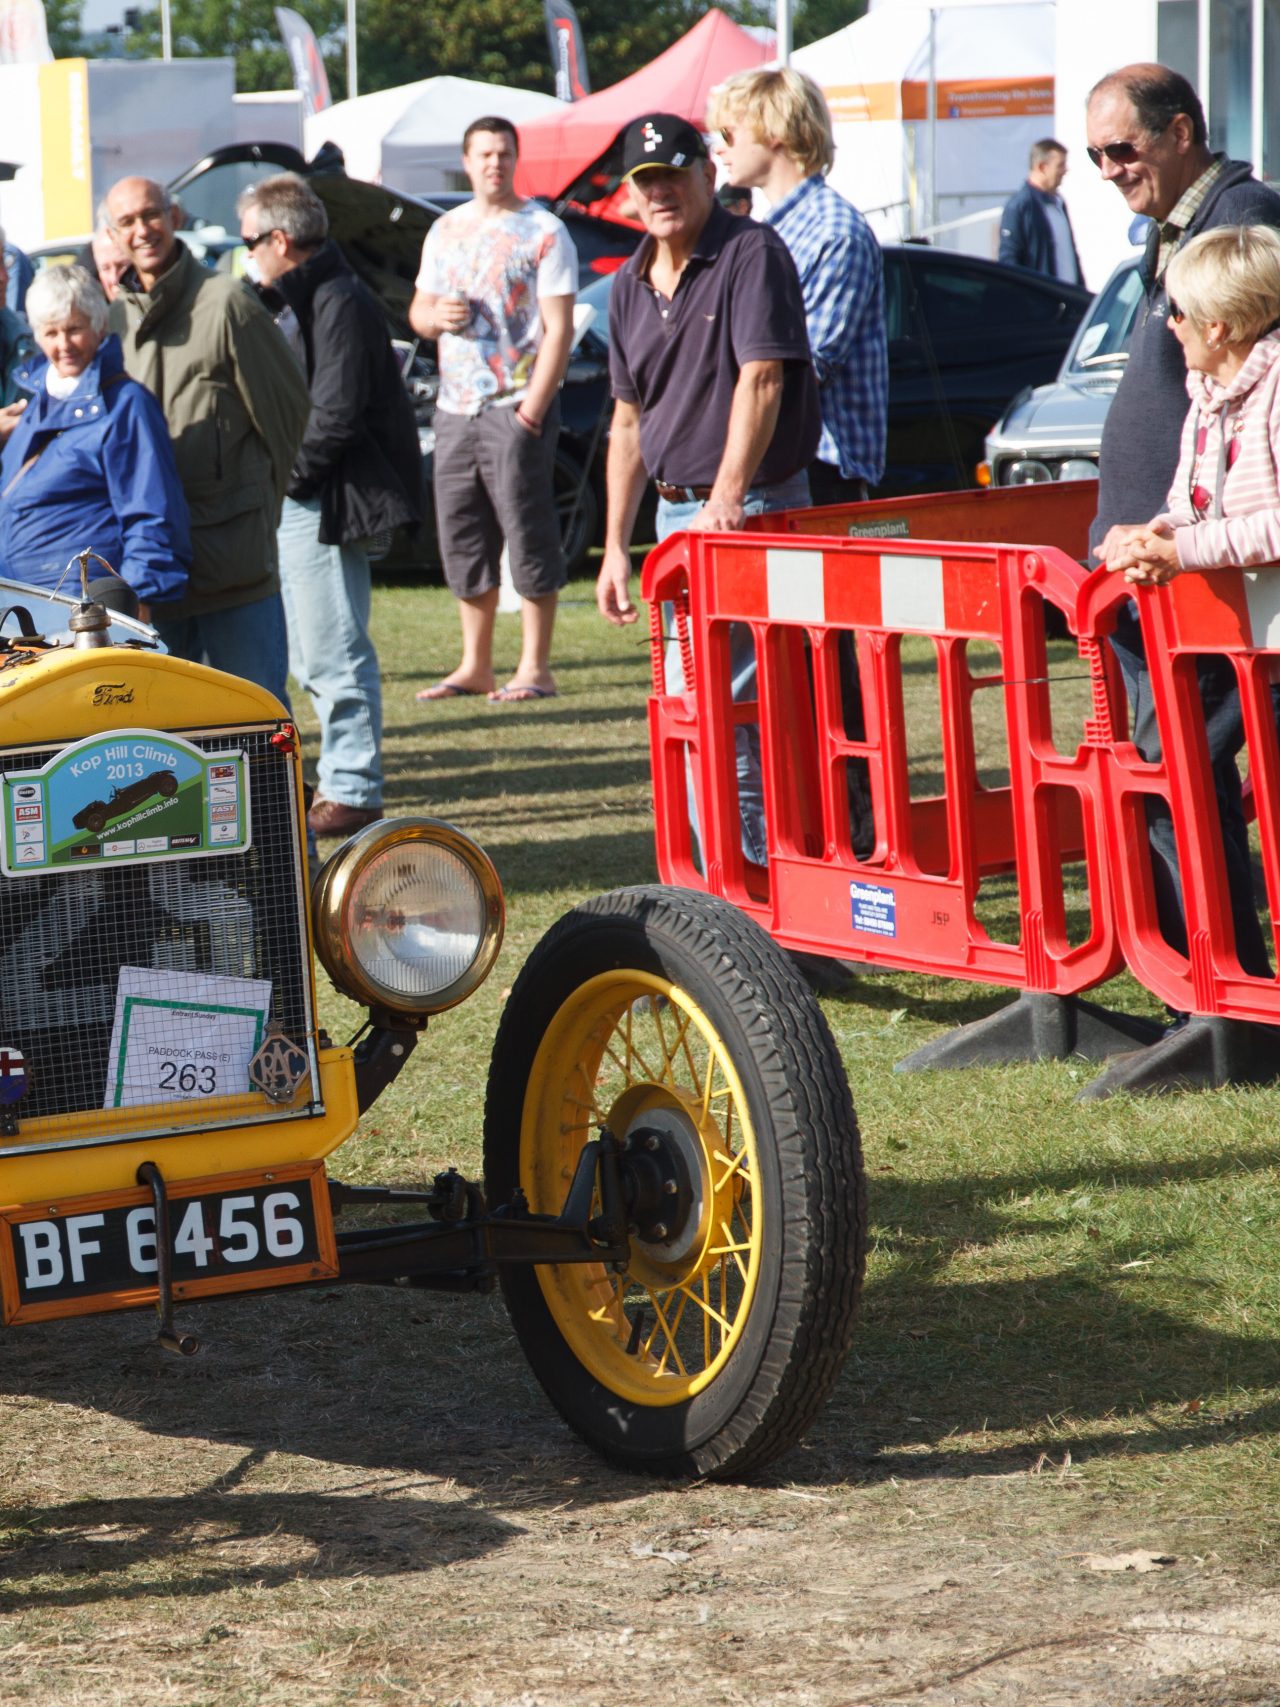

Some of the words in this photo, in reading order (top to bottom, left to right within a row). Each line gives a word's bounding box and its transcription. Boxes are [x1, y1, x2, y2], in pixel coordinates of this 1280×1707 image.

[93, 683, 135, 705] Ford
[70, 755, 102, 778] Kop
[105, 745, 128, 762] Hill
[132, 745, 178, 767] Climb
[106, 762, 144, 780] 2013
[18, 807, 39, 817] ASM
[96, 796, 179, 840] www.kophillclimb.info
[212, 804, 235, 814] FAST
[850, 883, 896, 906] Greenplant.
[931, 911, 950, 927] JSP
[171, 1009, 194, 1019] Entrant
[195, 1011, 217, 1021] Sunday
[148, 1045, 193, 1059] PADDOCK
[194, 1050, 218, 1062] PASS
[219, 1053, 231, 1064] (E)
[257, 1041, 301, 1089] RAC
[158, 1061, 217, 1094] 263
[19, 1212, 105, 1289] BF
[126, 1191, 305, 1274] 6456
